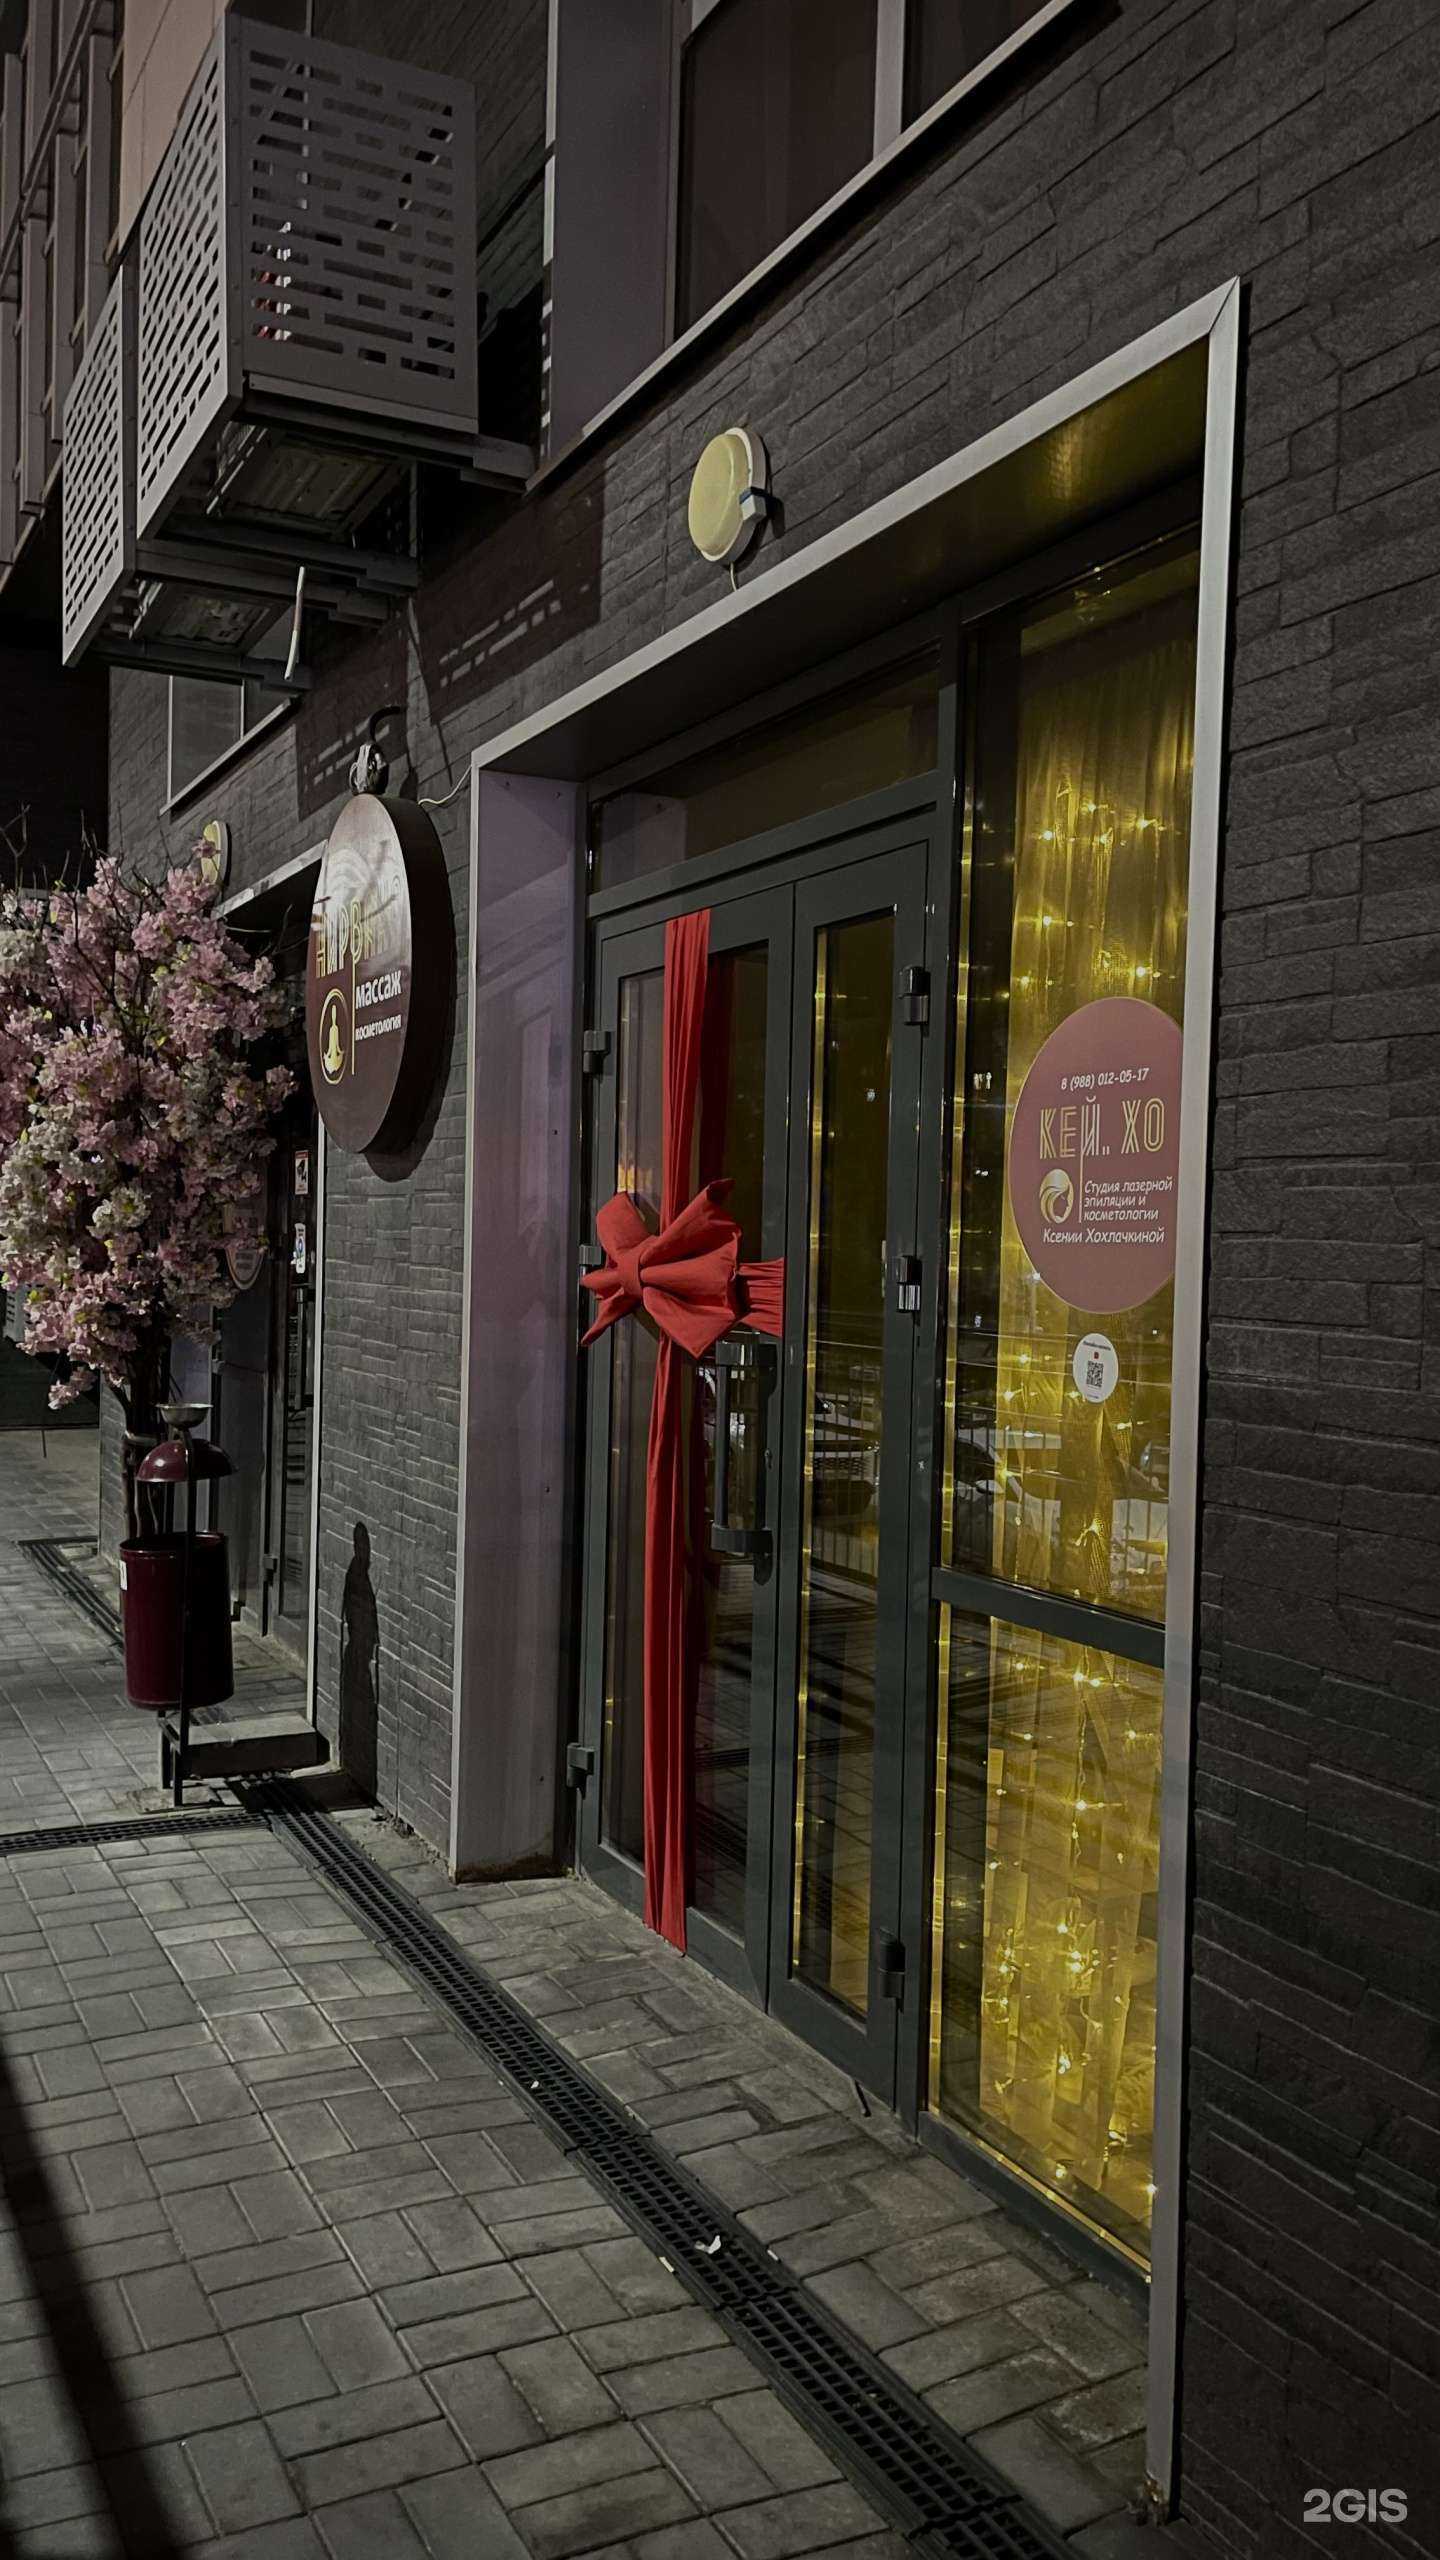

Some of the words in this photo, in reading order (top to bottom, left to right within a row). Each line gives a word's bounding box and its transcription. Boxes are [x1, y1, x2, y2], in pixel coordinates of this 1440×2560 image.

[355, 969, 402, 1010] массаж
[355, 1014, 402, 1042] косметология
[1061, 1077, 1067, 1091] 8
[1070, 1074, 1095, 1092] (988)
[1097, 1068, 1149, 1086] 012-05-17
[1120, 1097, 1165, 1155] ХО
[1084, 1179, 1119, 1196] Студия
[1121, 1176, 1173, 1196] лазерной
[1084, 1195, 1136, 1208] эпиляции
[1138, 1195, 1147, 1207] и
[1083, 1208, 1158, 1222] косметологии
[1043, 1228, 1083, 1243] Ксении
[1085, 1226, 1165, 1243] Хохлачкиной
